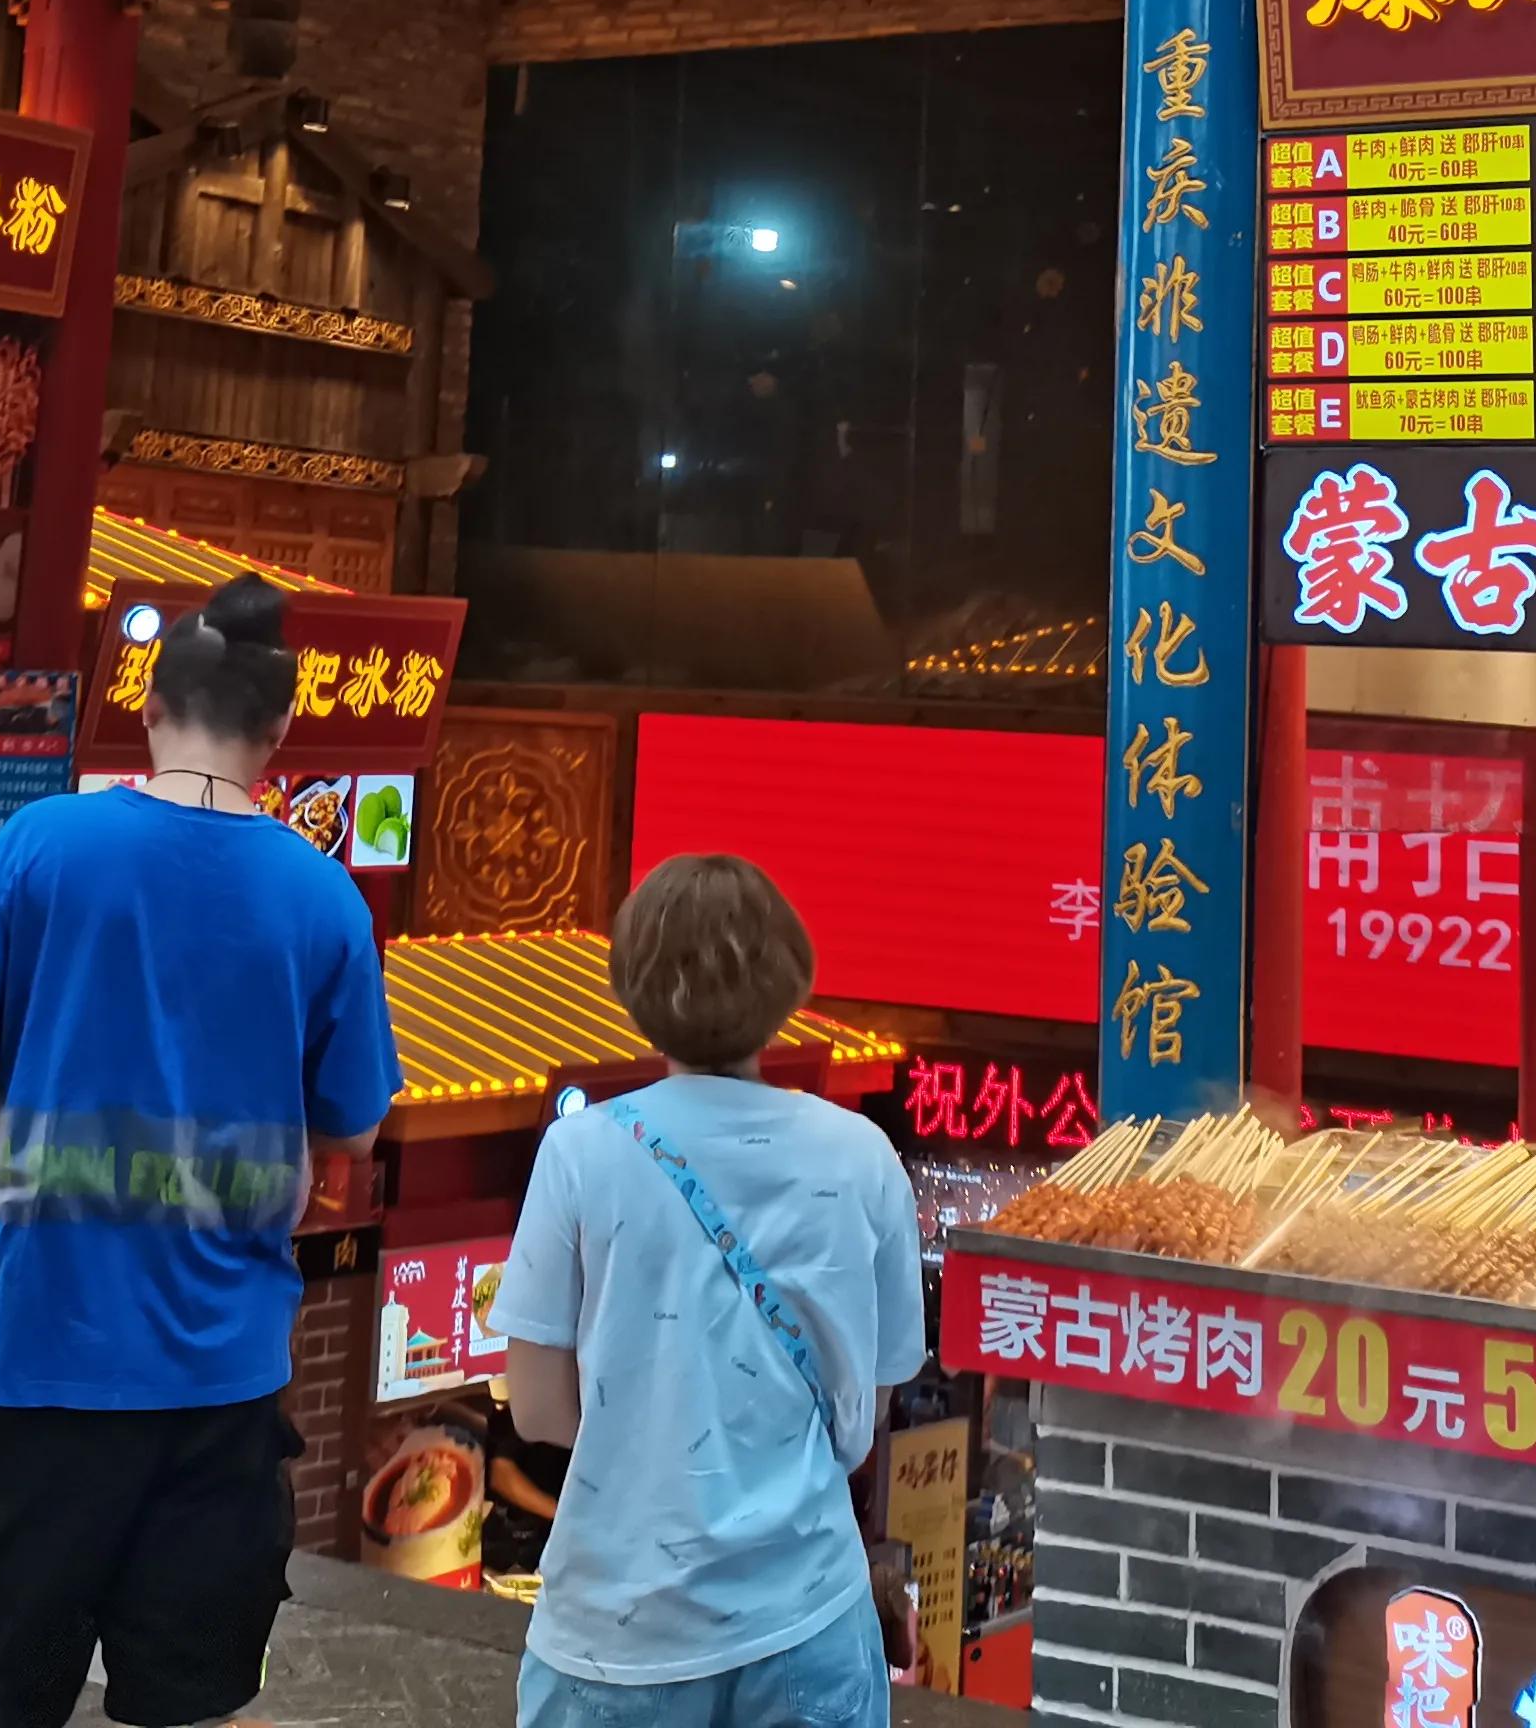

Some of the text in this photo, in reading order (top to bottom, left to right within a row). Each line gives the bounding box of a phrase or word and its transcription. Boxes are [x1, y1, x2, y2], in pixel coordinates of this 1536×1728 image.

[1271, 141, 1313, 164] 超值
[1352, 133, 1434, 159] 牛肉+鲜肉
[1440, 133, 1457, 152] 送
[1315, 149, 1343, 179] A
[1271, 166, 1313, 189] 套餐
[1271, 202, 1314, 226] 超值
[1440, 197, 1458, 216] 送
[1318, 210, 1341, 240] B
[1271, 227, 1314, 250] 套餐
[1271, 264, 1314, 288] 超值
[1458, 259, 1473, 279] 送
[1318, 272, 1341, 302] C
[1271, 289, 1314, 313] 套餐
[1271, 326, 1314, 350] 超值
[1460, 323, 1474, 343] 送
[1321, 331, 1344, 367] D
[1271, 351, 1314, 374] 套餐
[1272, 388, 1315, 411] 超值
[1464, 389, 1476, 408] 送
[1272, 413, 1315, 436] 套餐
[1320, 398, 1342, 428] E
[1112, 29, 1217, 1068] 重庆非遗文化体验馆
[1049, 877, 1100, 941] 李
[1328, 907, 1513, 971] 19922
[906, 1055, 1098, 1147] 祝外公
